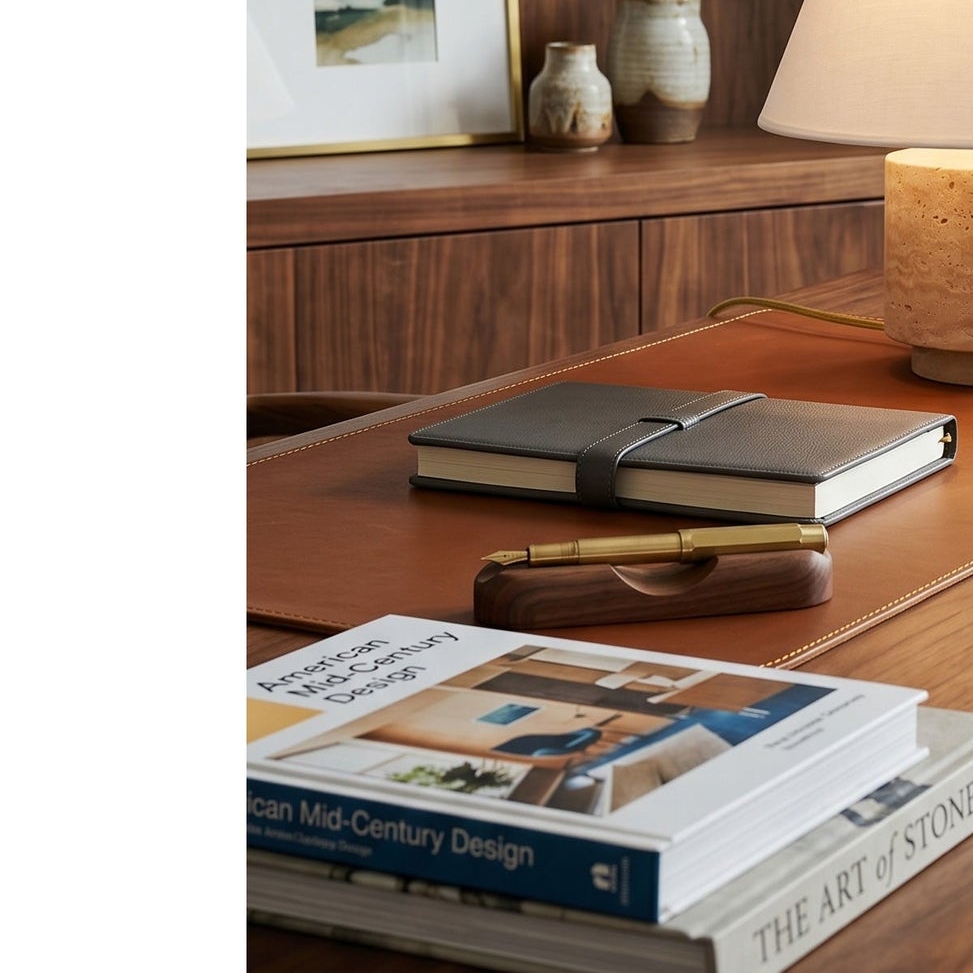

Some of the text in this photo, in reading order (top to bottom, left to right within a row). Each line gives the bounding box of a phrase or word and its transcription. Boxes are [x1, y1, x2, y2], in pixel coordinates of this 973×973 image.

[257, 638, 389, 692] American
[287, 631, 459, 698] Mid-Century
[324, 664, 426, 704] Design
[299, 800, 444, 854] Mid-Century
[452, 828, 534, 870] Design
[753, 897, 809, 963] THE
[818, 857, 868, 923] ART
[876, 831, 899, 888] of
